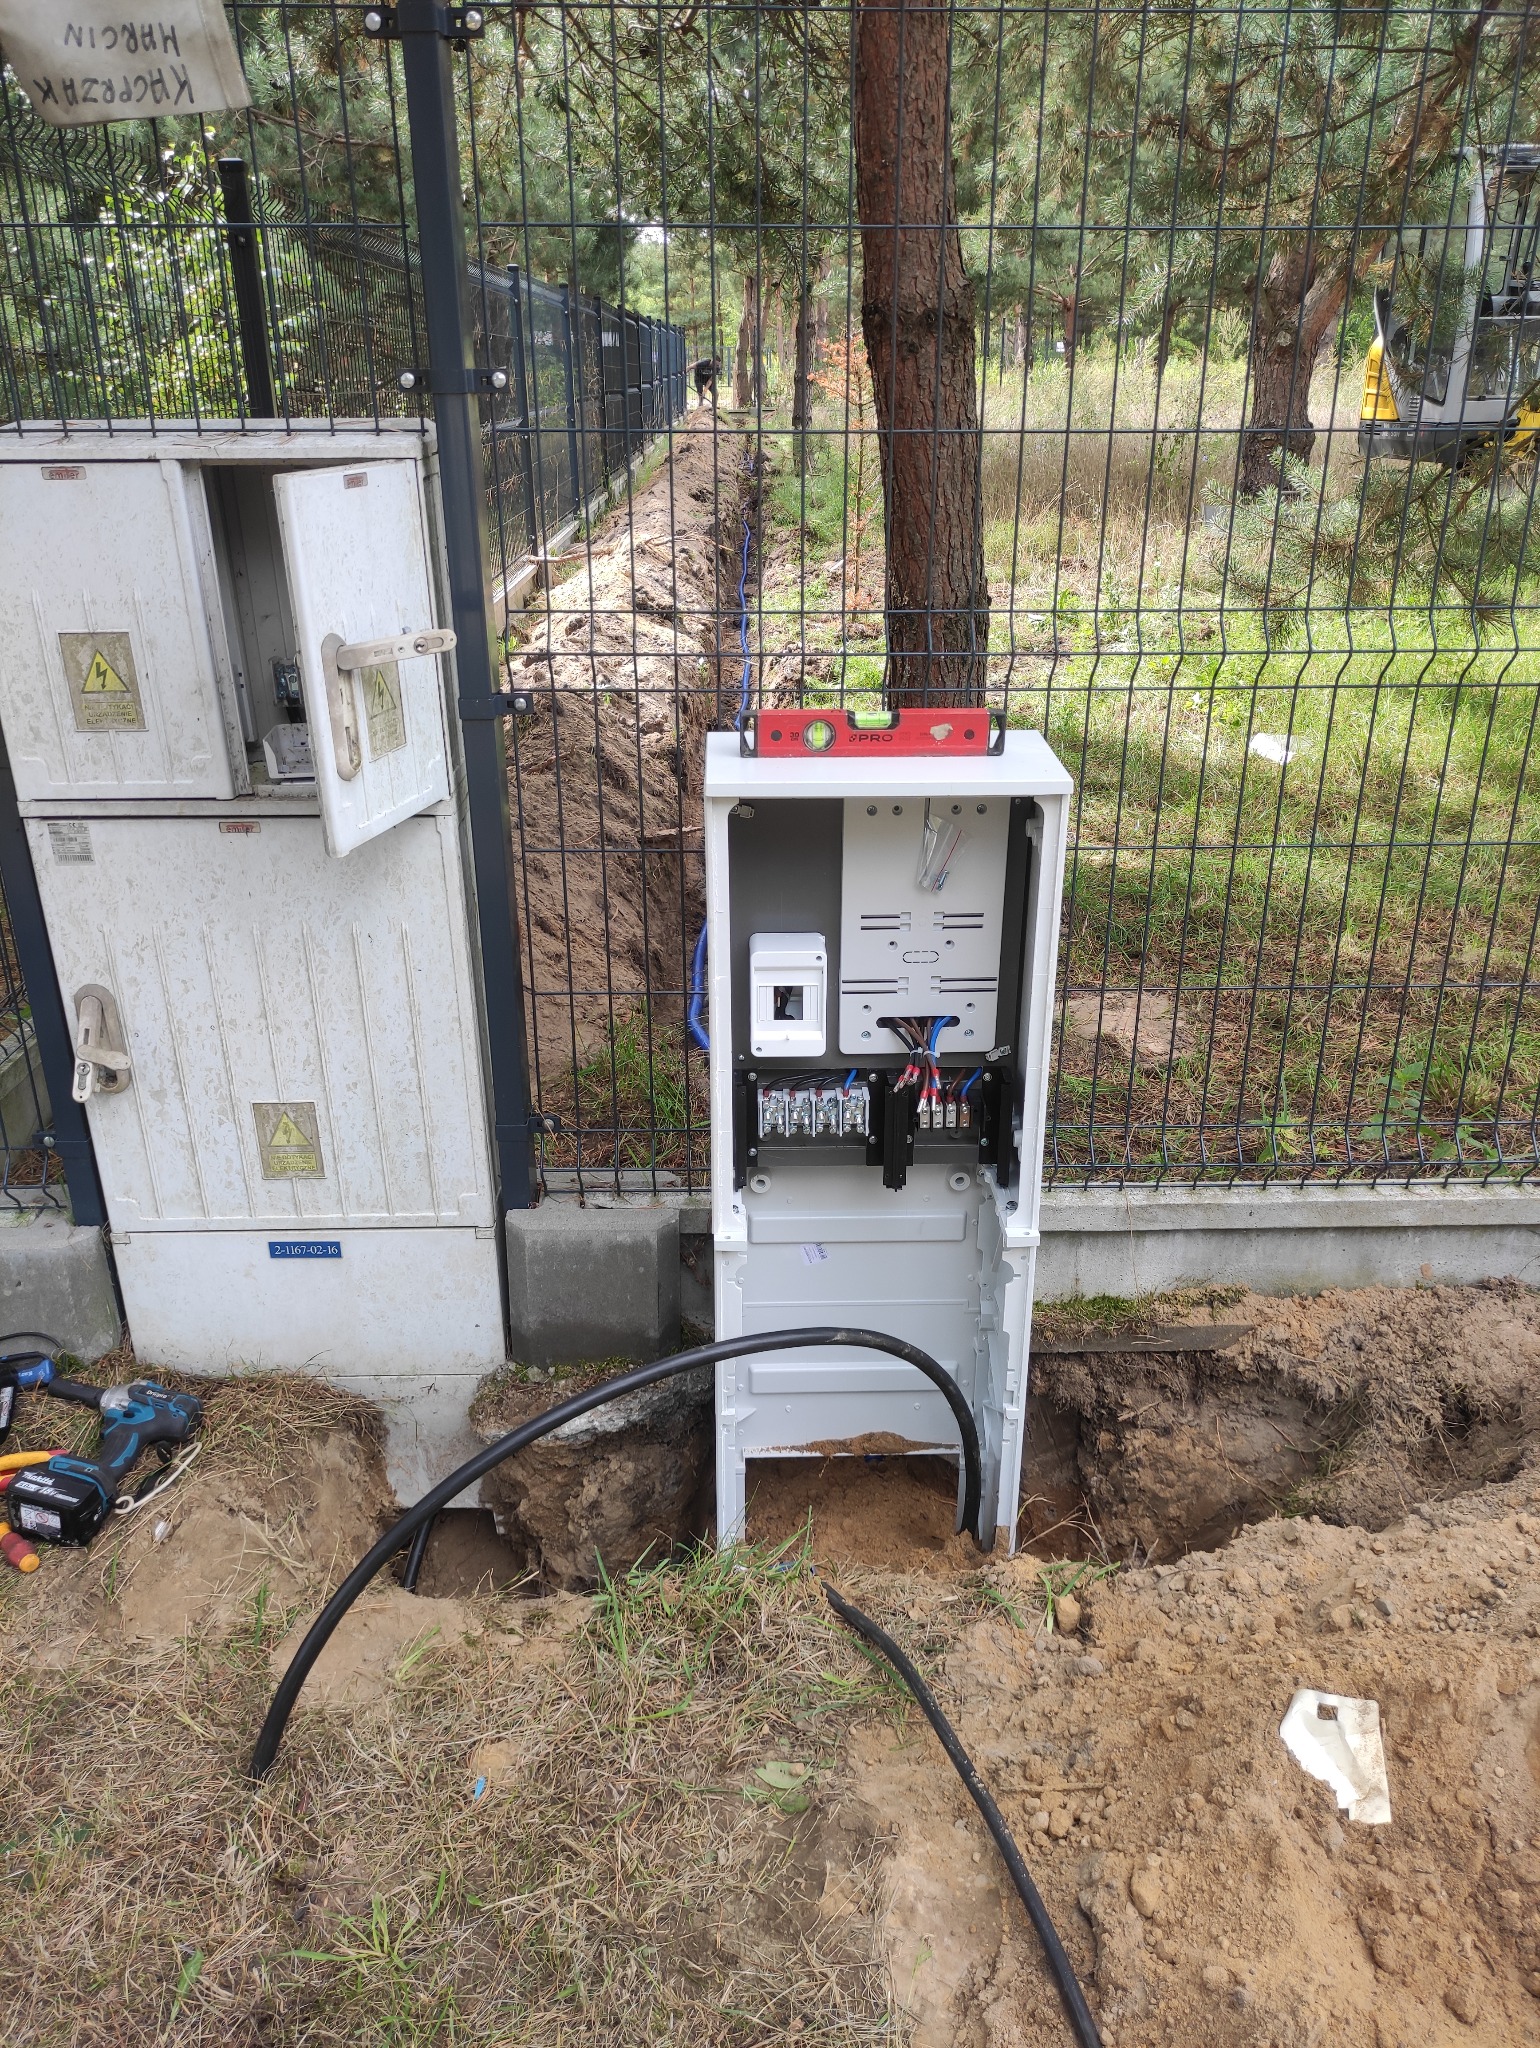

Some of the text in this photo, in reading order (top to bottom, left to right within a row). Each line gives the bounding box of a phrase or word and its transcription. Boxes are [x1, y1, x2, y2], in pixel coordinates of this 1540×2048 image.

[63, 21, 181, 58] MARCIN
[33, 63, 196, 107] KACPRZAK
[858, 733, 894, 743] PRO
[273, 1245, 339, 1255] 2-1167-02-16
